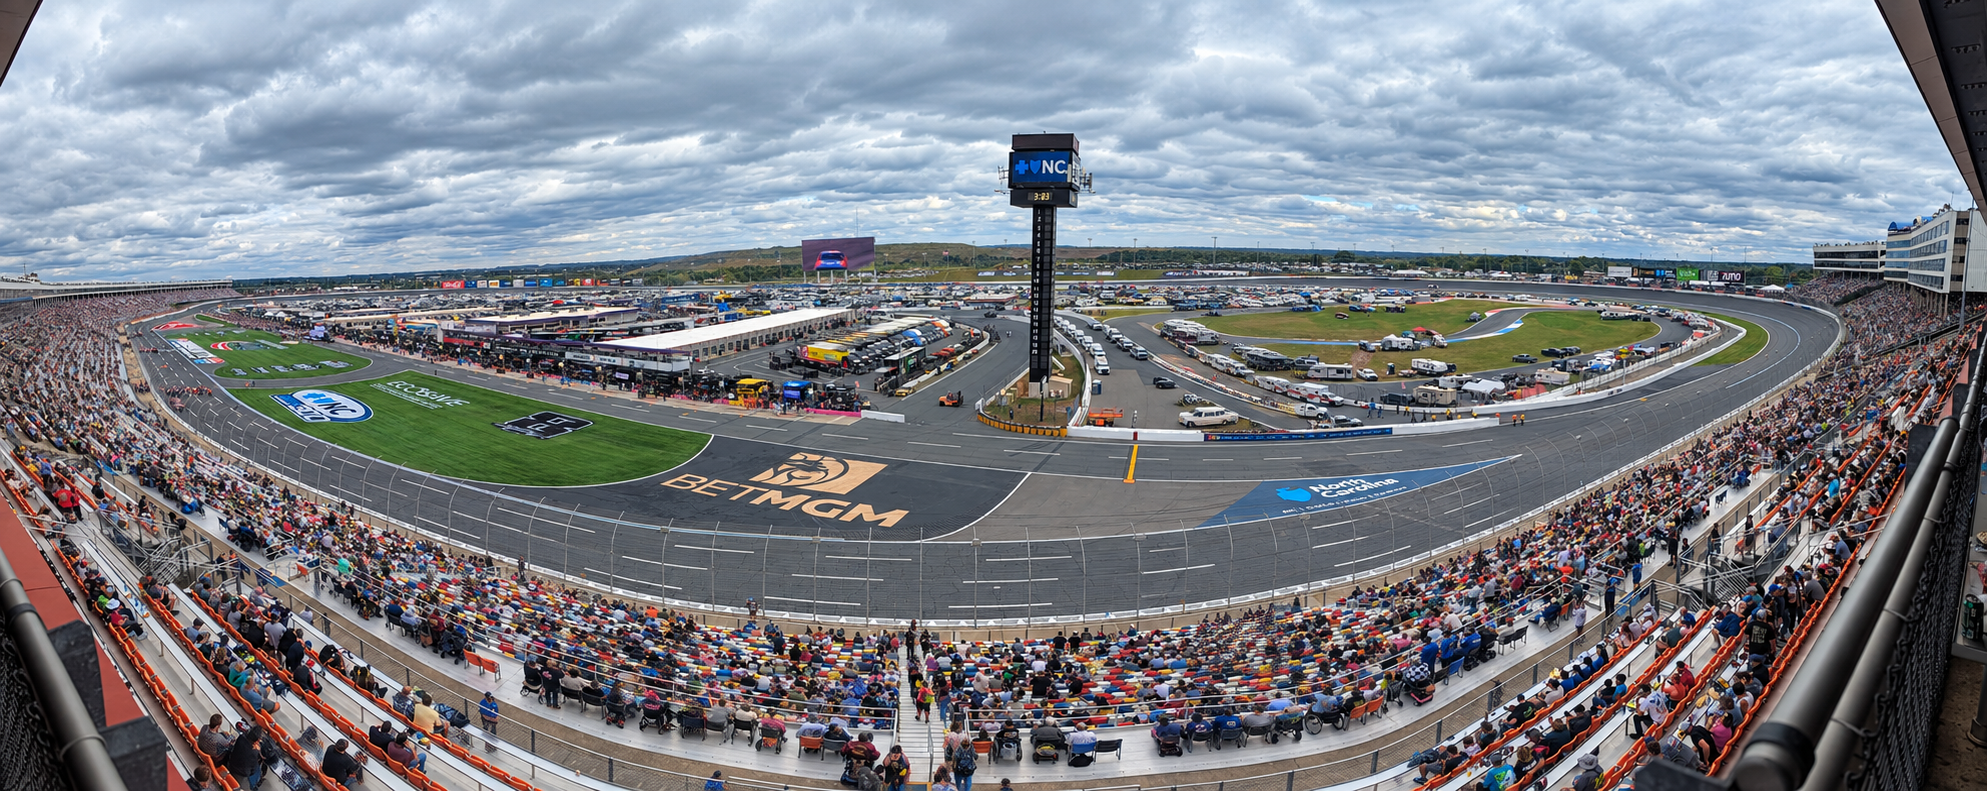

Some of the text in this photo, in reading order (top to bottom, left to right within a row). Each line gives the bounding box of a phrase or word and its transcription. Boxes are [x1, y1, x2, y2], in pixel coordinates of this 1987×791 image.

[1042, 159, 1066, 174] NC
[317, 402, 357, 415] NC
[1308, 477, 1368, 493] North
[1320, 477, 1400, 498] Carolina
[660, 473, 910, 527] BETMGM
